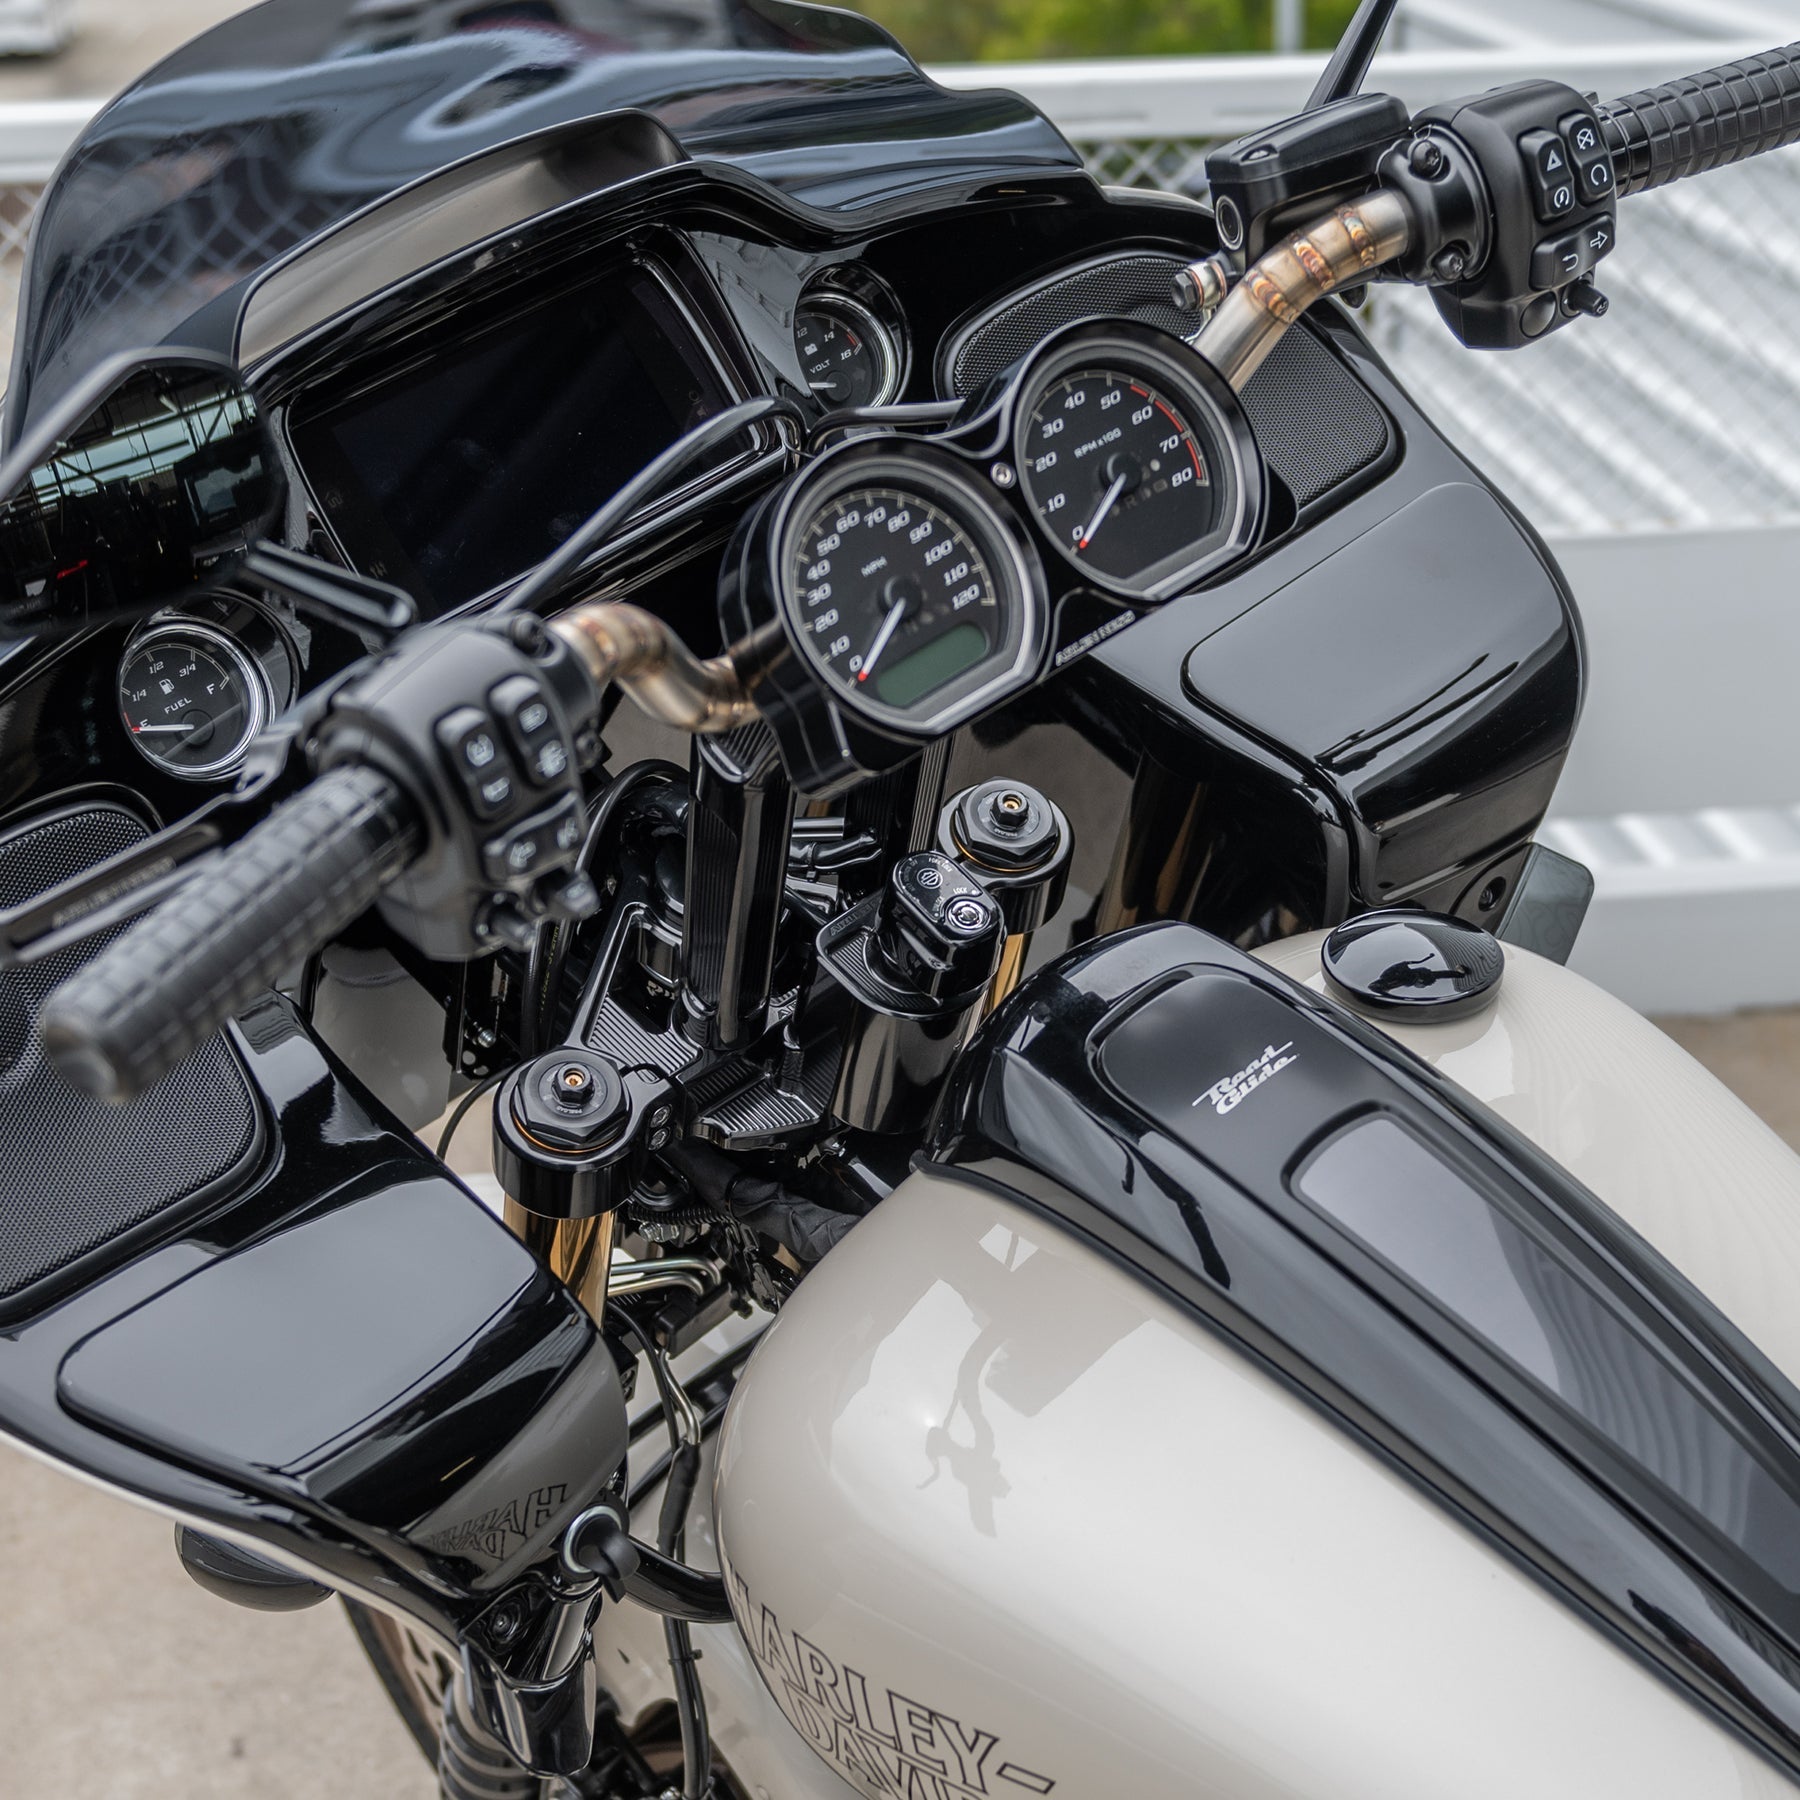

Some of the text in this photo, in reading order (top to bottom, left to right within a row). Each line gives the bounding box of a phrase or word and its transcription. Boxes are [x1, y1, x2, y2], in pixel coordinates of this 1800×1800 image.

[796, 327, 808, 338] 12
[824, 331, 835, 343] 14
[840, 349, 852, 361] 16
[809, 360, 831, 374] VOLT
[1064, 390, 1085, 410] 40
[1100, 390, 1121, 410] 50
[1131, 405, 1153, 426] 60
[1042, 418, 1064, 439] 30
[1073, 440, 1098, 459] RPM
[1159, 434, 1179, 454] 70
[1035, 451, 1057, 473] 20
[1171, 467, 1193, 488] 80
[1048, 493, 1066, 513] 10
[836, 510, 860, 534] 60
[864, 506, 887, 528] 70
[887, 510, 911, 533] 80
[909, 521, 932, 544] 90
[1072, 525, 1084, 541] 0
[816, 533, 841, 557] 50
[924, 539, 953, 566] 100
[807, 559, 831, 581] 40
[860, 556, 888, 577] MPH
[943, 562, 968, 586] 110
[807, 583, 832, 607] 30
[952, 584, 980, 611] 120
[814, 608, 839, 633] 20
[830, 635, 850, 657] 10
[149, 661, 164, 674] 1/2
[179, 663, 197, 677] 3/4
[849, 654, 863, 672] 0
[132, 689, 147, 702] 1/4
[206, 683, 215, 695] F
[164, 697, 192, 714] FUEL
[1192, 1041, 1294, 1107] Road
[1216, 1054, 1298, 1115] Glide
